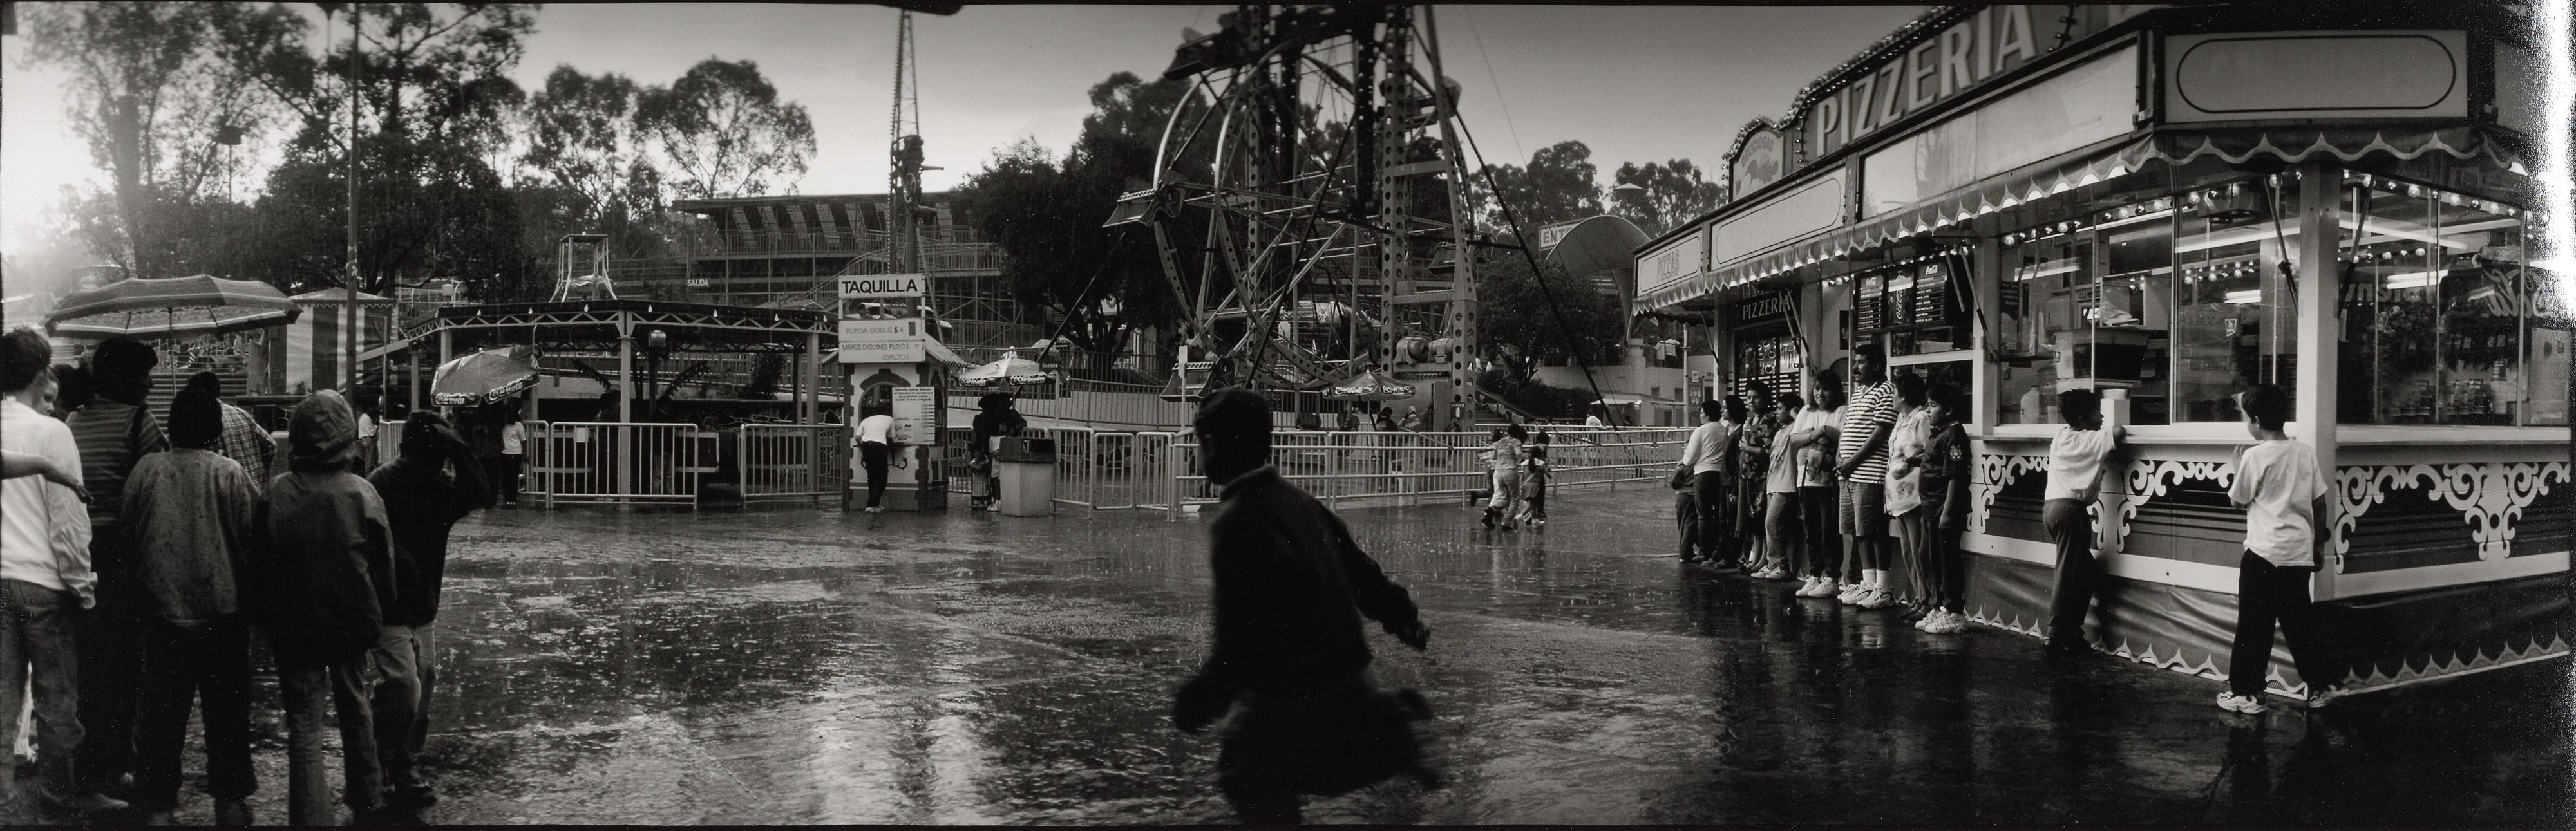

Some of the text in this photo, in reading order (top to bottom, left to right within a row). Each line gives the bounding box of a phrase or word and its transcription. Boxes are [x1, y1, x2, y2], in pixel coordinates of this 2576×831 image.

[1817, 5, 2038, 158] PIZZERIA
[1543, 227, 1573, 244] ENT
[1656, 248, 1680, 283] PIZZAS
[842, 279, 918, 294] TAQUILLA
[1743, 294, 1790, 320] PIZZERIA
[436, 392, 465, 404] Coca-Cola
[489, 380, 524, 401] Coca-Cola
